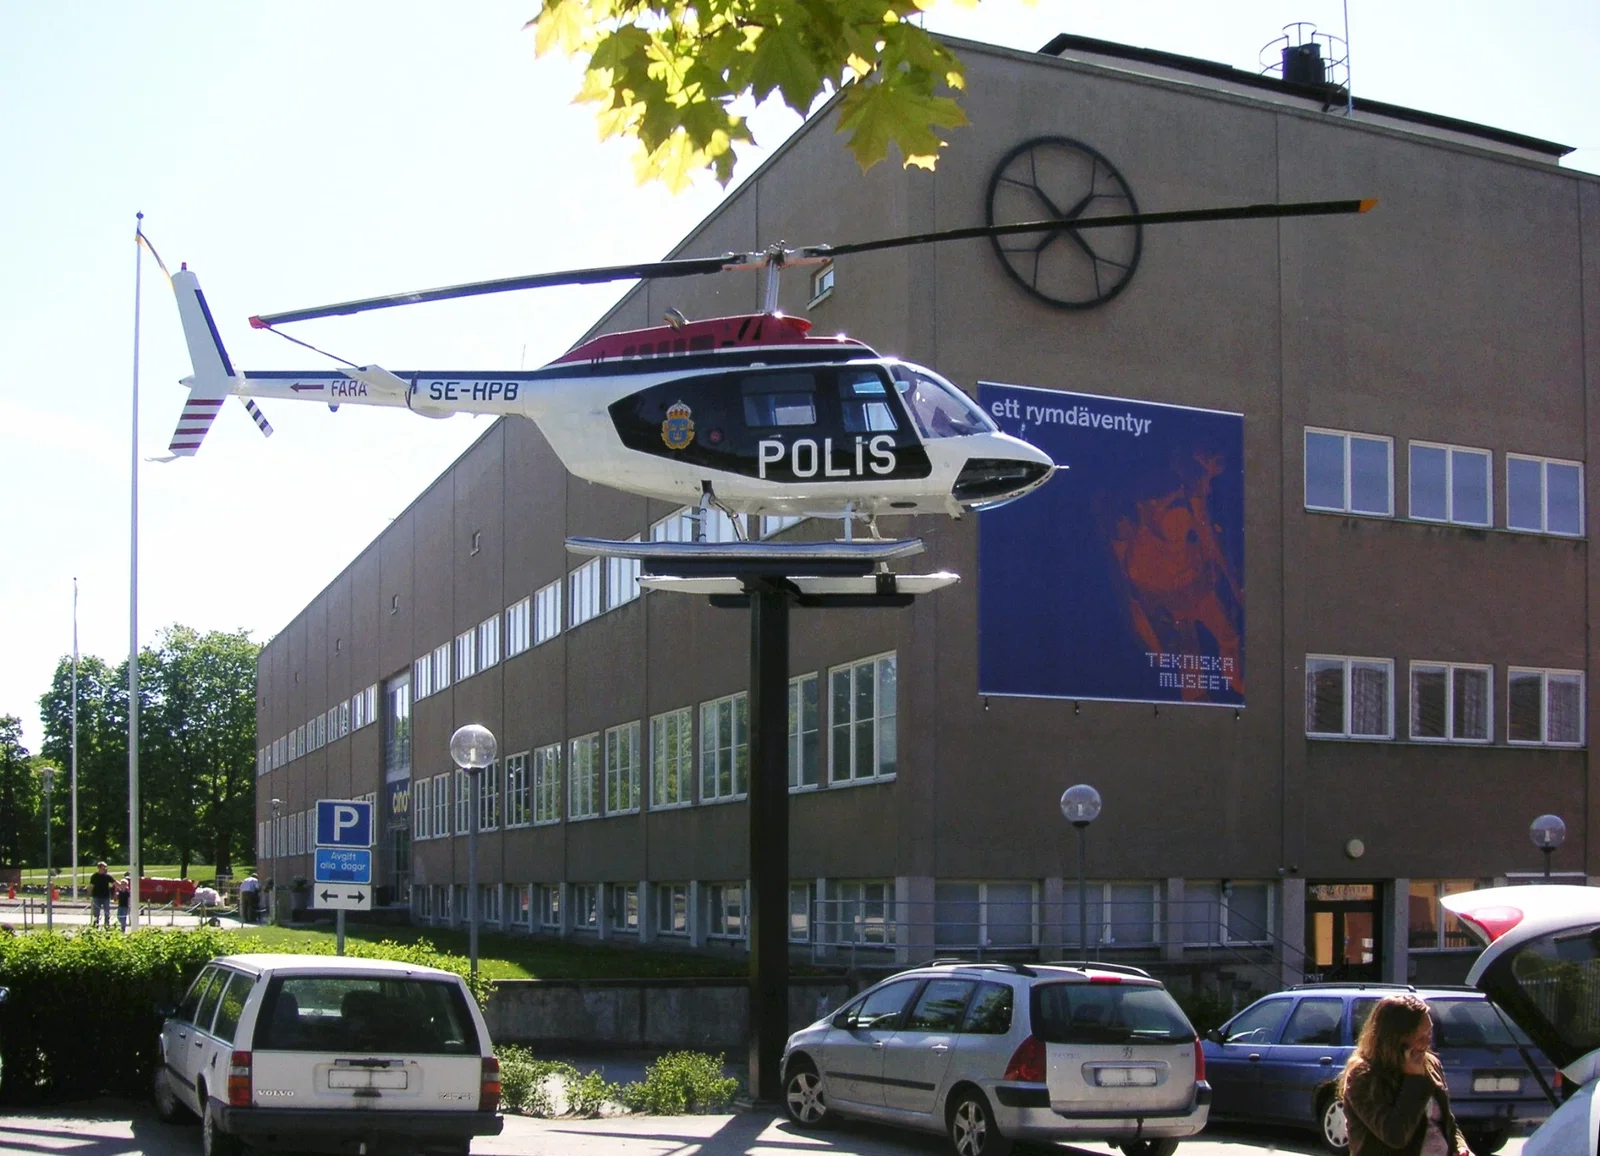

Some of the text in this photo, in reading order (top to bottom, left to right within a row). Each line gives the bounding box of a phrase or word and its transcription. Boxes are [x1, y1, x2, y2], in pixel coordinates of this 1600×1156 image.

[331, 380, 367, 397] FARA
[429, 381, 519, 401] SE-HPB
[991, 399, 1152, 437] ett rymdäventyr
[758, 435, 897, 479] POLIS
[1145, 652, 1234, 672] TEKNISKA
[1159, 672, 1234, 690] MUSEET
[333, 805, 359, 842] P
[330, 851, 356, 862] Avgift
[319, 861, 366, 872] alla dagar
[257, 1089, 294, 1098] VOLVO
